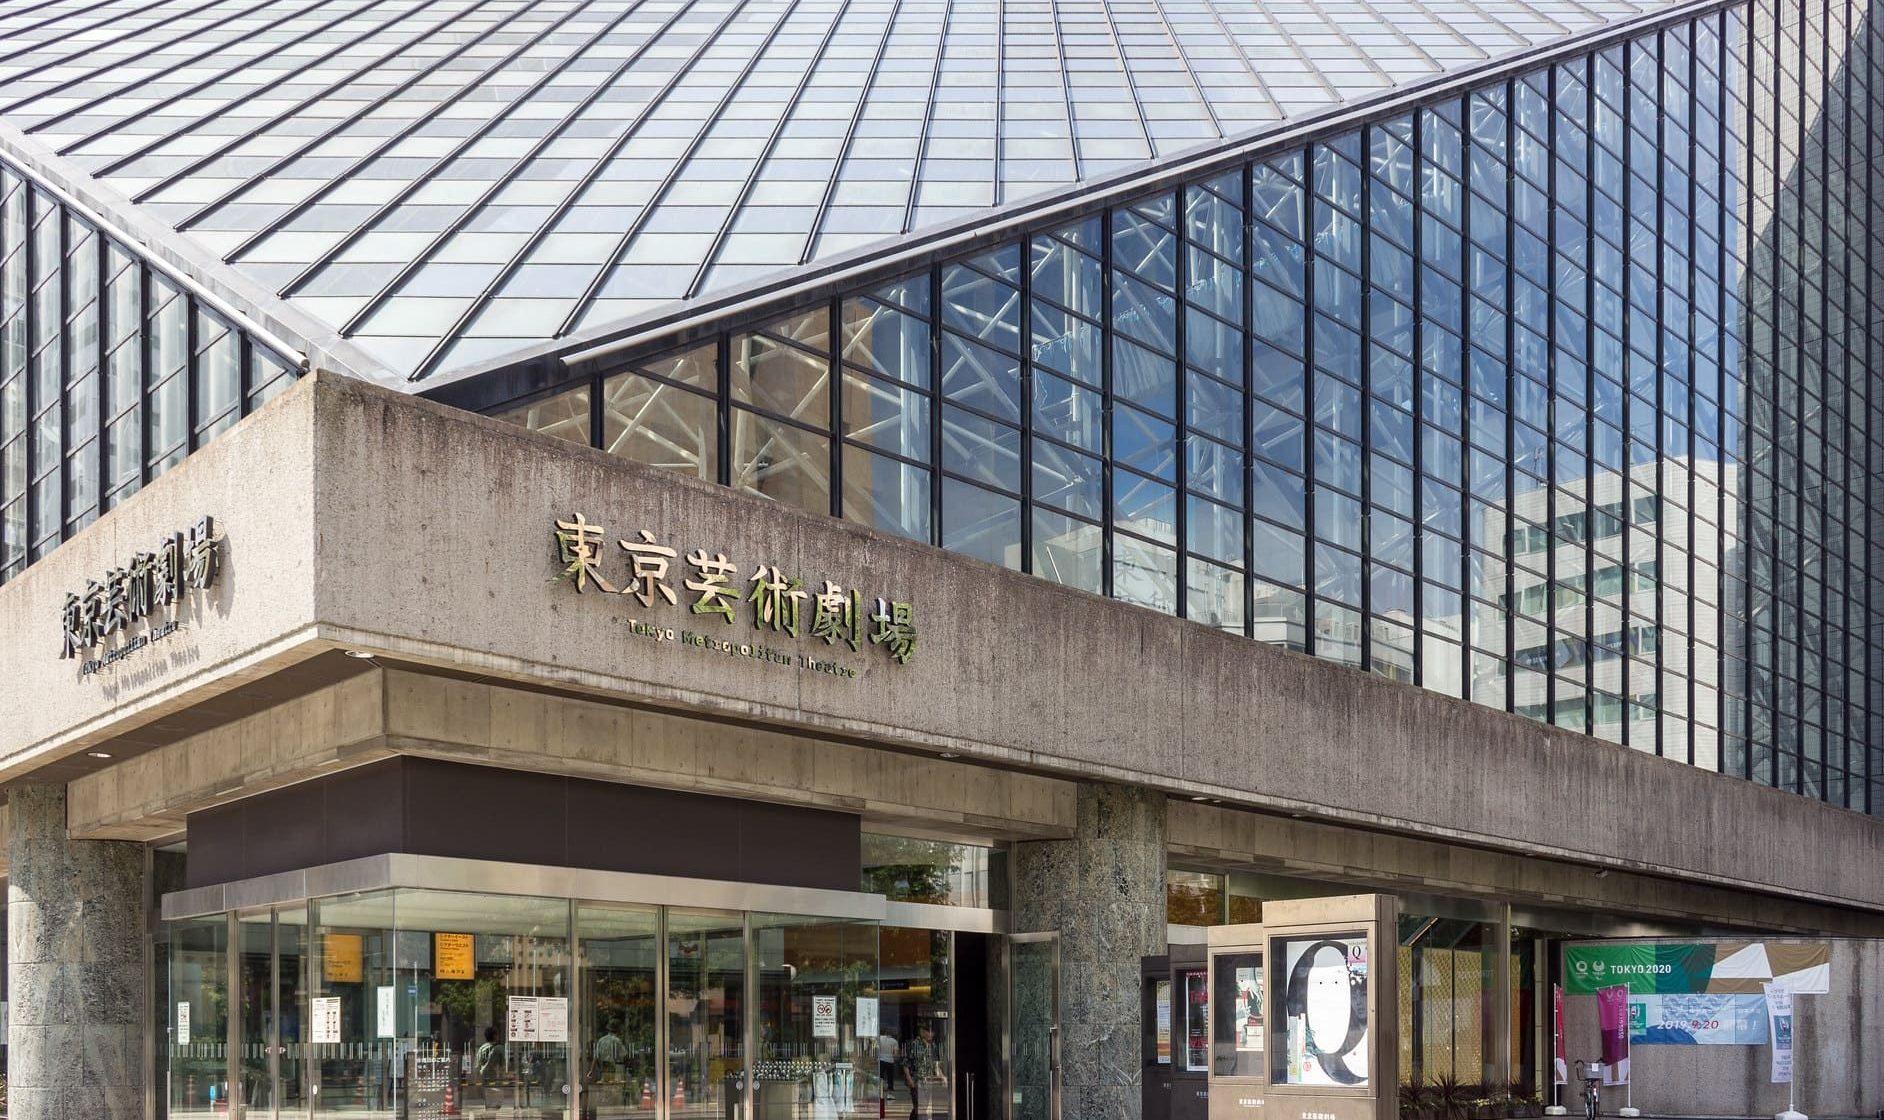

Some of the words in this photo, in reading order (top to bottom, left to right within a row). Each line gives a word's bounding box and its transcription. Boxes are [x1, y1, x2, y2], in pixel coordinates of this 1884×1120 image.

[58, 514, 220, 660] 東京芸術劇場
[548, 511, 918, 665] 東京芸術劇場
[626, 617, 675, 642] Tokyo
[680, 629, 794, 667] Metropolitan
[797, 654, 859, 680] Theatre
[1610, 964, 1644, 975] TOKYO
[1645, 964, 1672, 974] 2020
